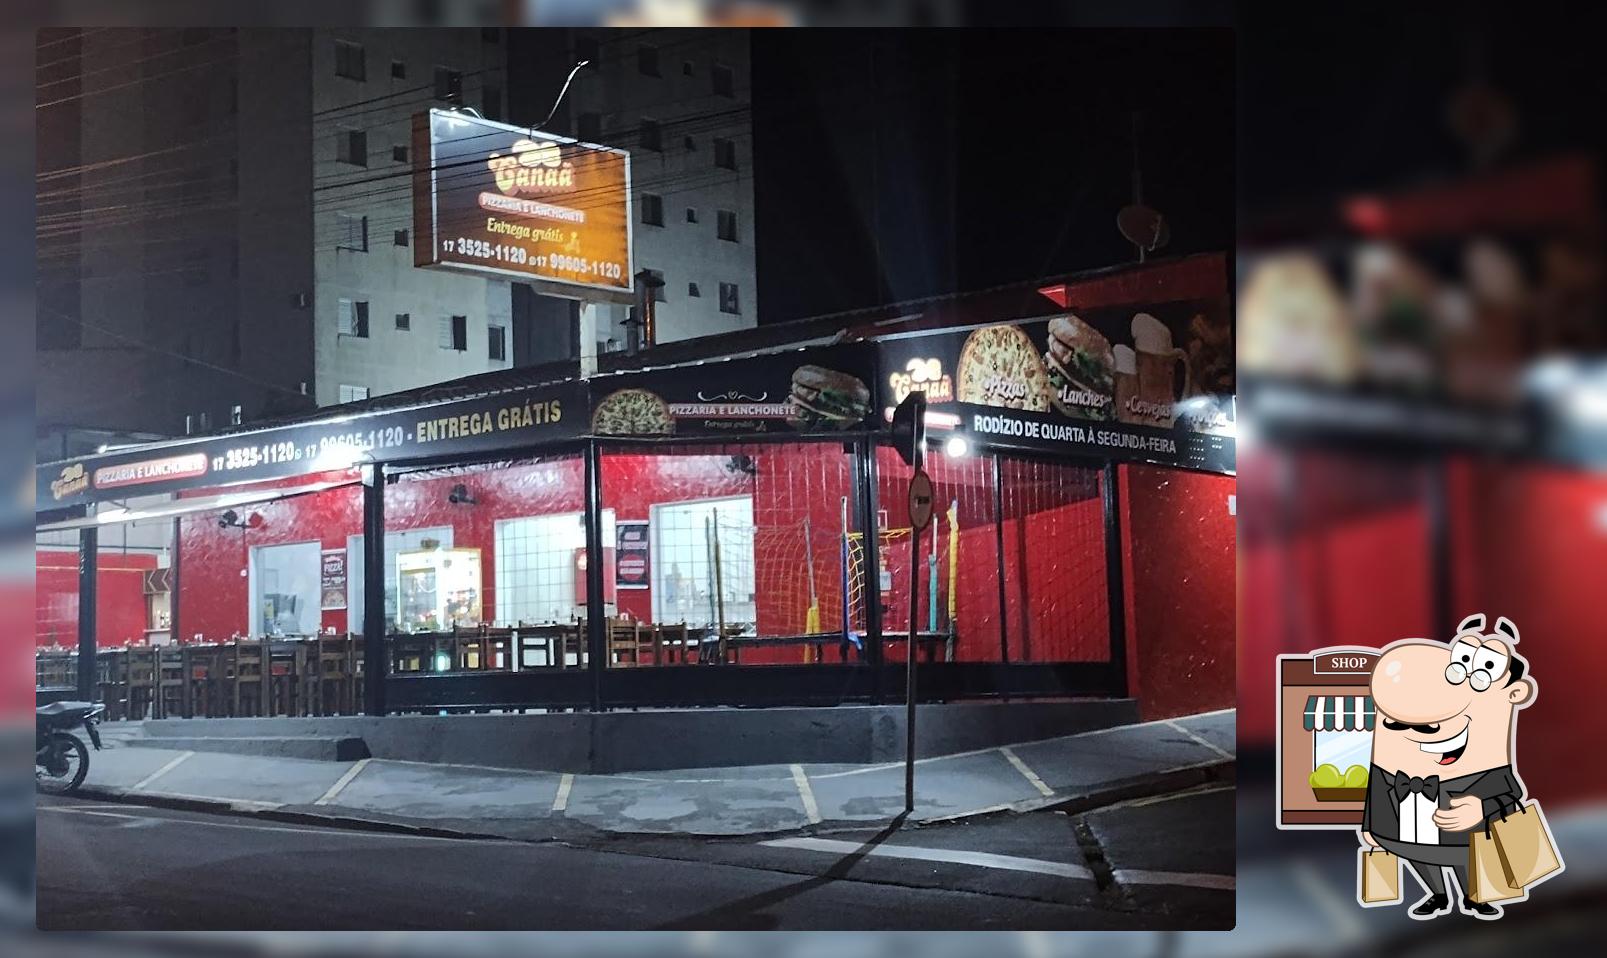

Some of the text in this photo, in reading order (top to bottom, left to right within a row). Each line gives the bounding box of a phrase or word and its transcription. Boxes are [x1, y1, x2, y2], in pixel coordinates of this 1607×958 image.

[488, 217, 564, 243] Entrega grátis
[443, 237, 621, 279] 17 3525-1120 17 99605-1120
[989, 375, 1026, 399] Pizzas
[1062, 384, 1105, 407] Lanches
[669, 404, 795, 416] PIZZARIA E LANCHONETE
[96, 469, 135, 484] PIZZARIA
[137, 467, 143, 478] E
[213, 457, 224, 471] 17
[226, 442, 294, 470] 3525-1120
[305, 444, 317, 458] 17
[416, 411, 493, 444] ENTREGA
[498, 398, 562, 431] GRÁTIS
[974, 414, 1023, 436] RODÍZIO
[1025, 424, 1039, 437] DE
[1041, 426, 1085, 443] QUARTA
[1087, 427, 1095, 443] À
[1097, 431, 1176, 454] SEGUNDA-FEIRA
